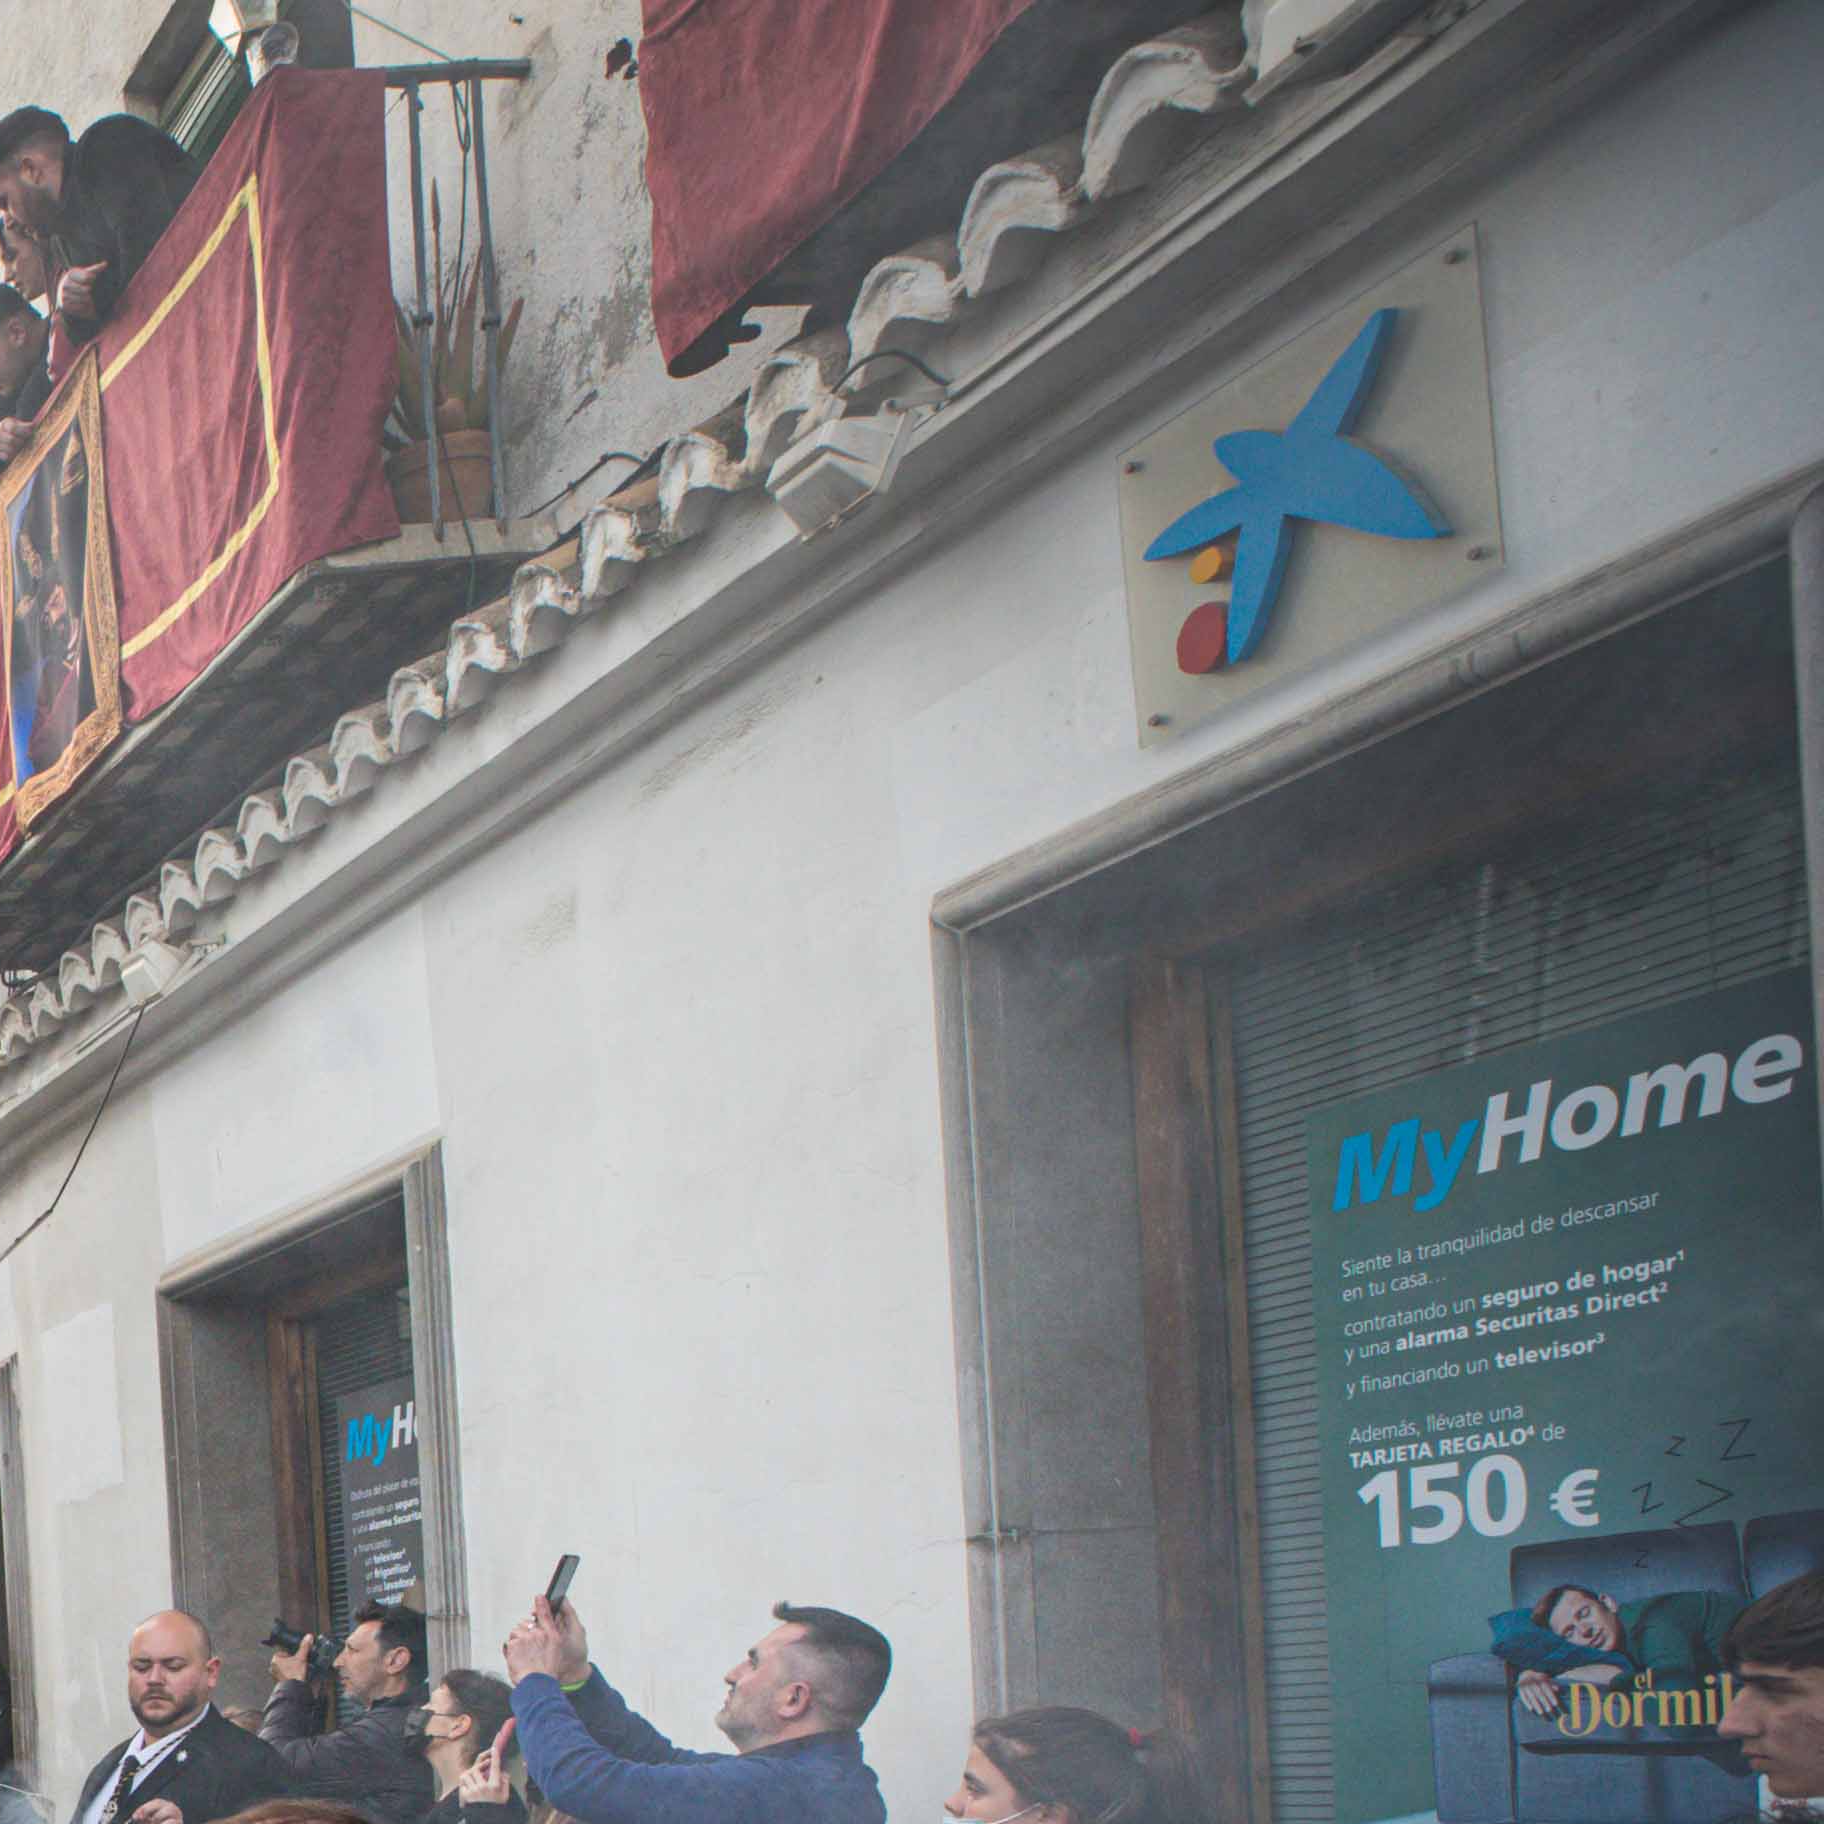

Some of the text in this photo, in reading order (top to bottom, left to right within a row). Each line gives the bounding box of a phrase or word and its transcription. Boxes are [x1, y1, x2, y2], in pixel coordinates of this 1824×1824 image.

[1331, 1032, 1803, 1212] MyHome
[1341, 1191, 1660, 1278] Siente la tranquilidad de descansar
[1342, 1286, 1363, 1302] en
[1368, 1281, 1385, 1297] tu
[1344, 1301, 1447, 1337] contratando
[1454, 1298, 1475, 1314] un
[1481, 1281, 1559, 1308] seguro
[1566, 1271, 1595, 1290] de
[1344, 1348, 1353, 1366] y
[1359, 1341, 1390, 1359] una
[1396, 1325, 1469, 1351] alarma
[1475, 1303, 1579, 1336] Securitas
[1346, 1382, 1356, 1400] y
[1361, 1360, 1460, 1392] financiando
[1466, 1358, 1489, 1375] un
[1349, 1404, 1524, 1444] Además, llévate una
[1349, 1443, 1432, 1469] TARJETA
[1542, 1424, 1566, 1442] de
[1357, 1454, 1600, 1548] 150 €
[1635, 1668, 1652, 1689] el
